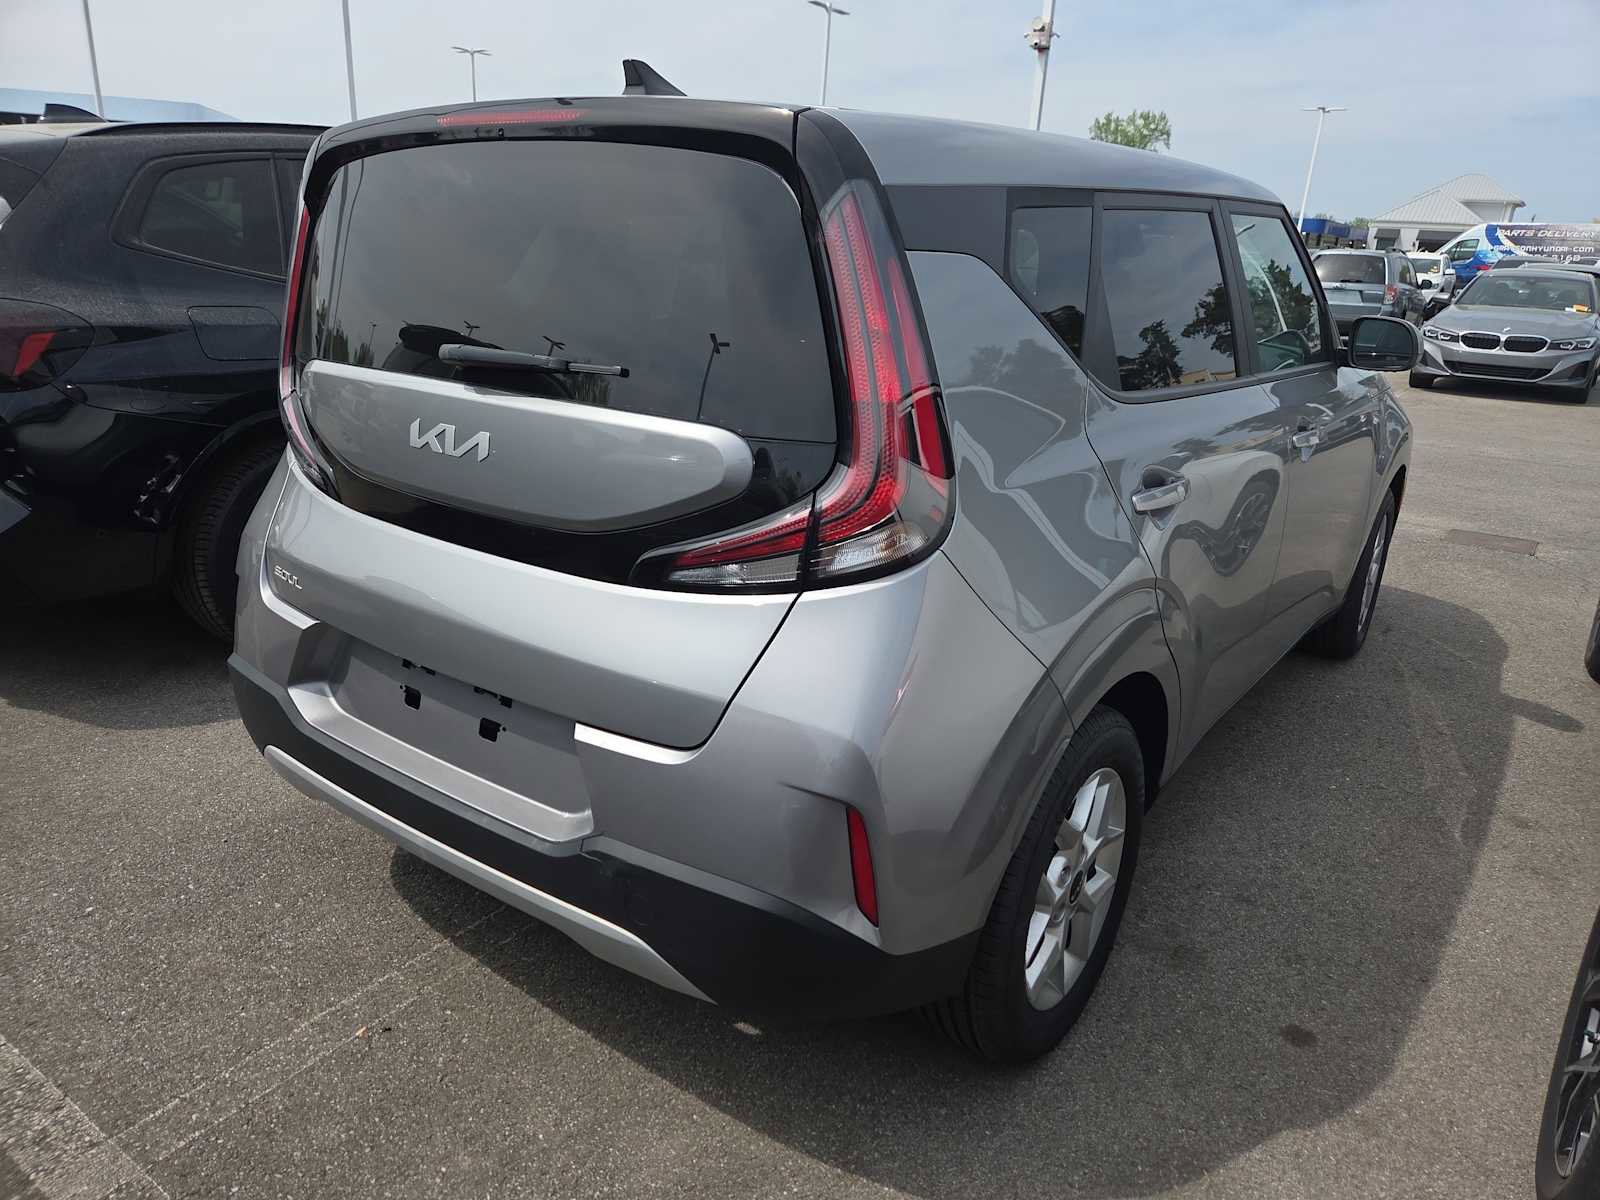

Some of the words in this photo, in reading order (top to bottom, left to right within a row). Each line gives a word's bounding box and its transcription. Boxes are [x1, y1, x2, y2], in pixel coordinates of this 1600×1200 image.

[1496, 229, 1535, 237] PARTS
[1537, 229, 1595, 239] DELIVERY
[409, 417, 490, 462] KIA
[274, 565, 303, 589] SOUL
